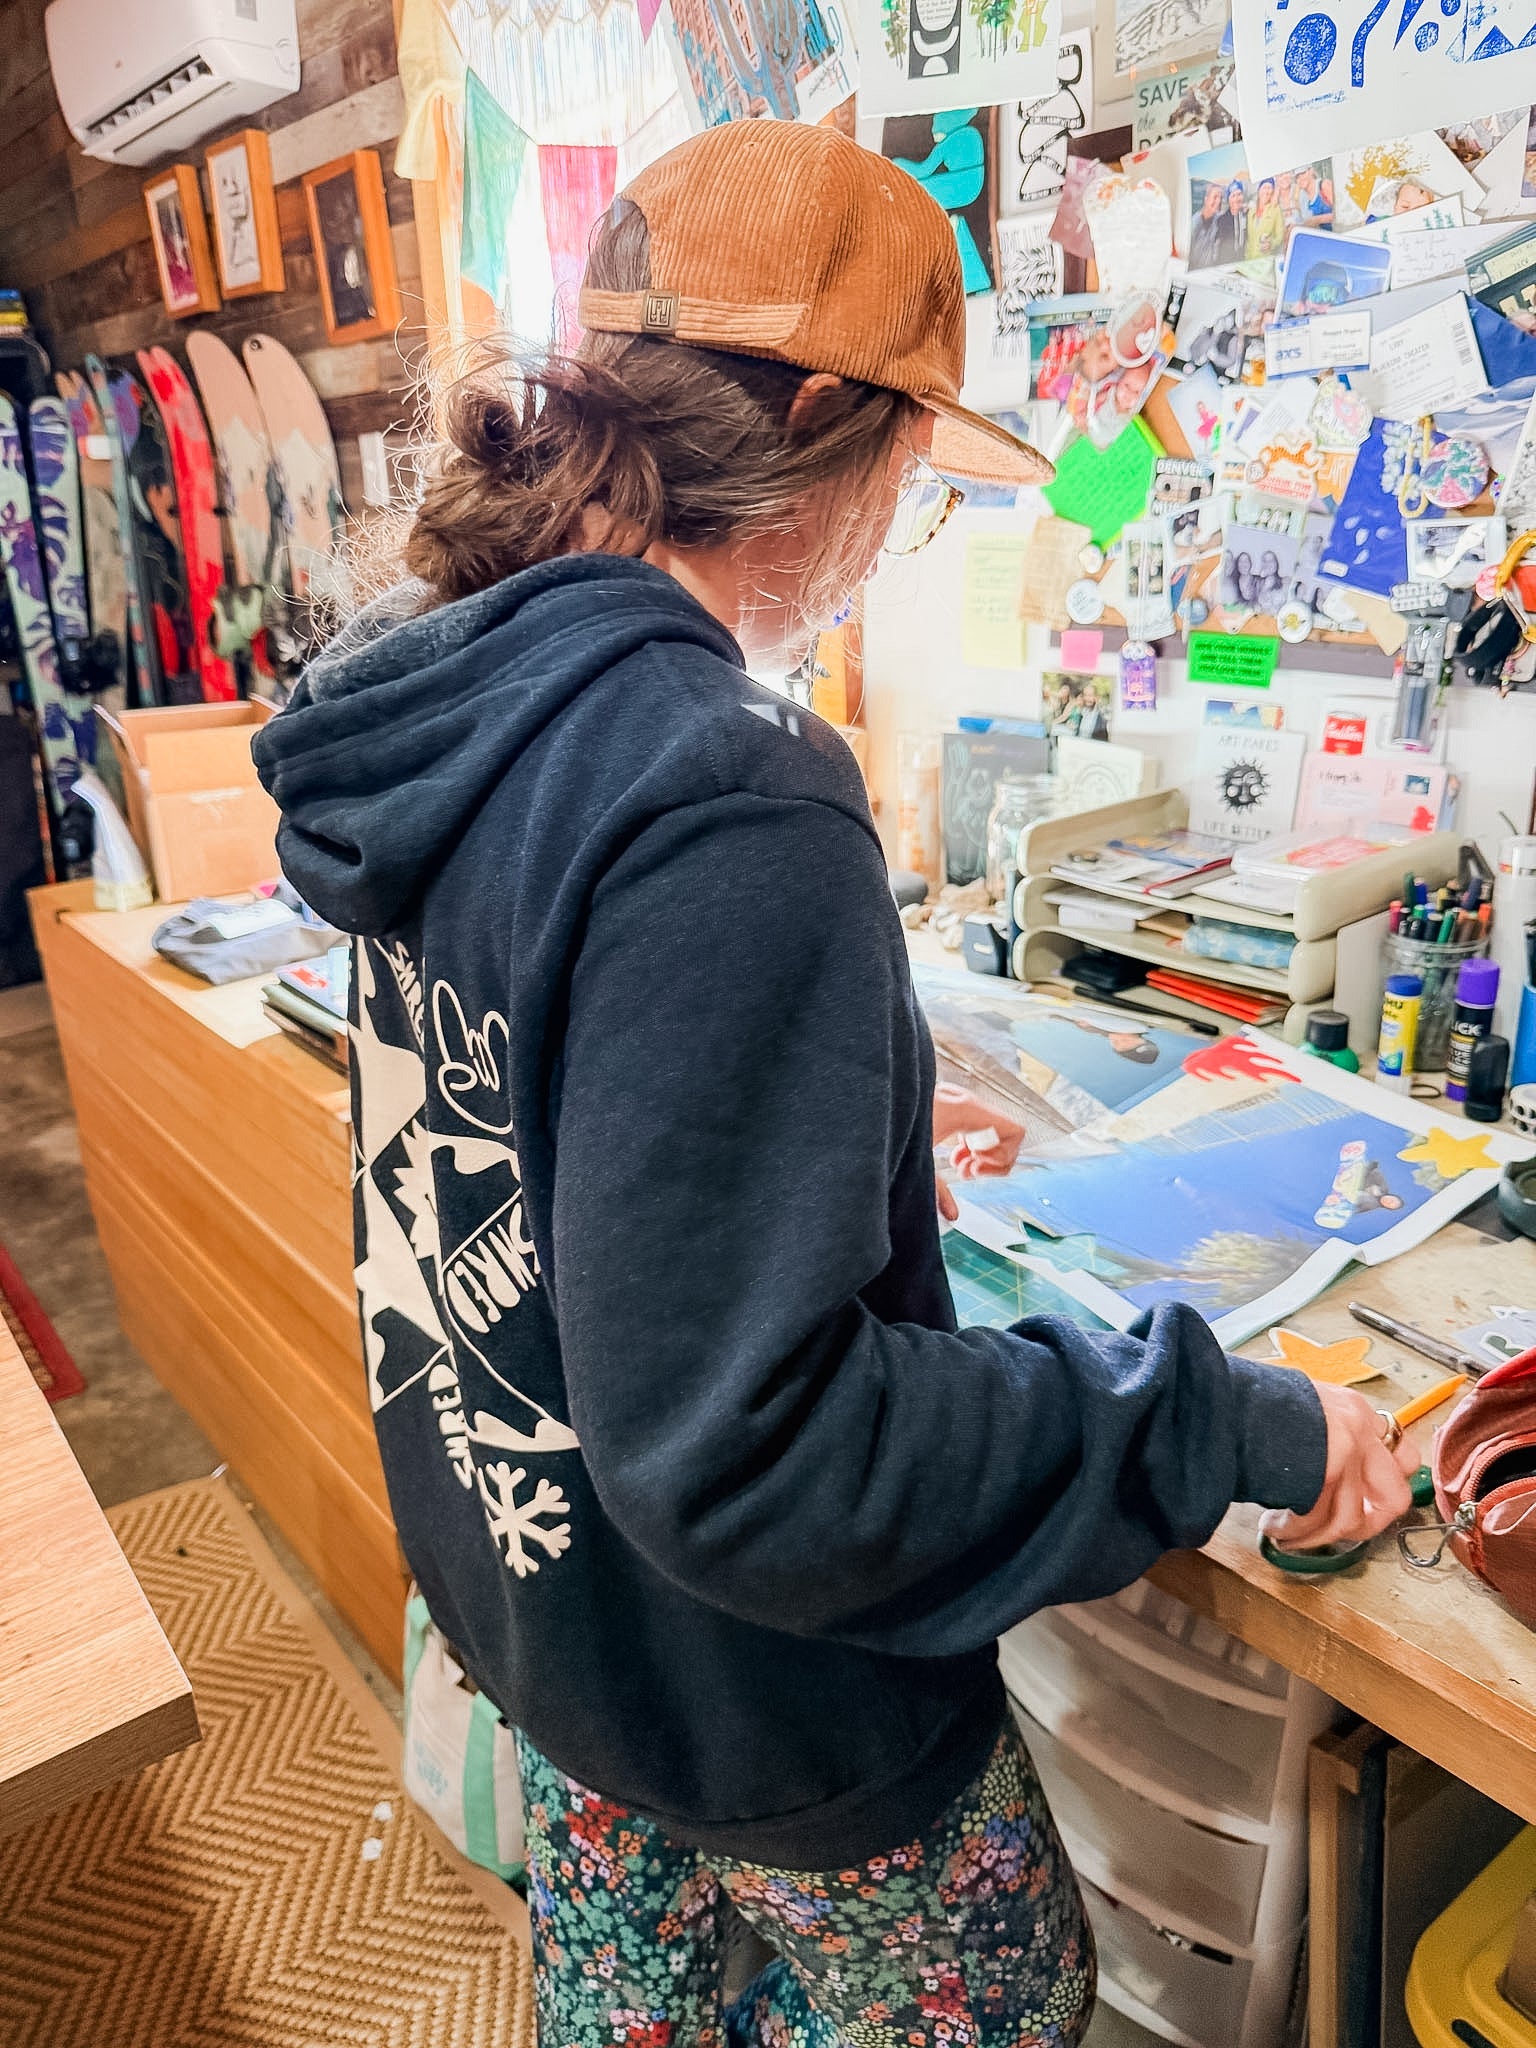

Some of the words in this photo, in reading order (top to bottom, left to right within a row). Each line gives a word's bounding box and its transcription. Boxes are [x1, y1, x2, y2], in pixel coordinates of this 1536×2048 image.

[1138, 76, 1189, 108] SAVE
[446, 1202, 541, 1335] SHRED
[428, 1363, 475, 1491] SHRED
